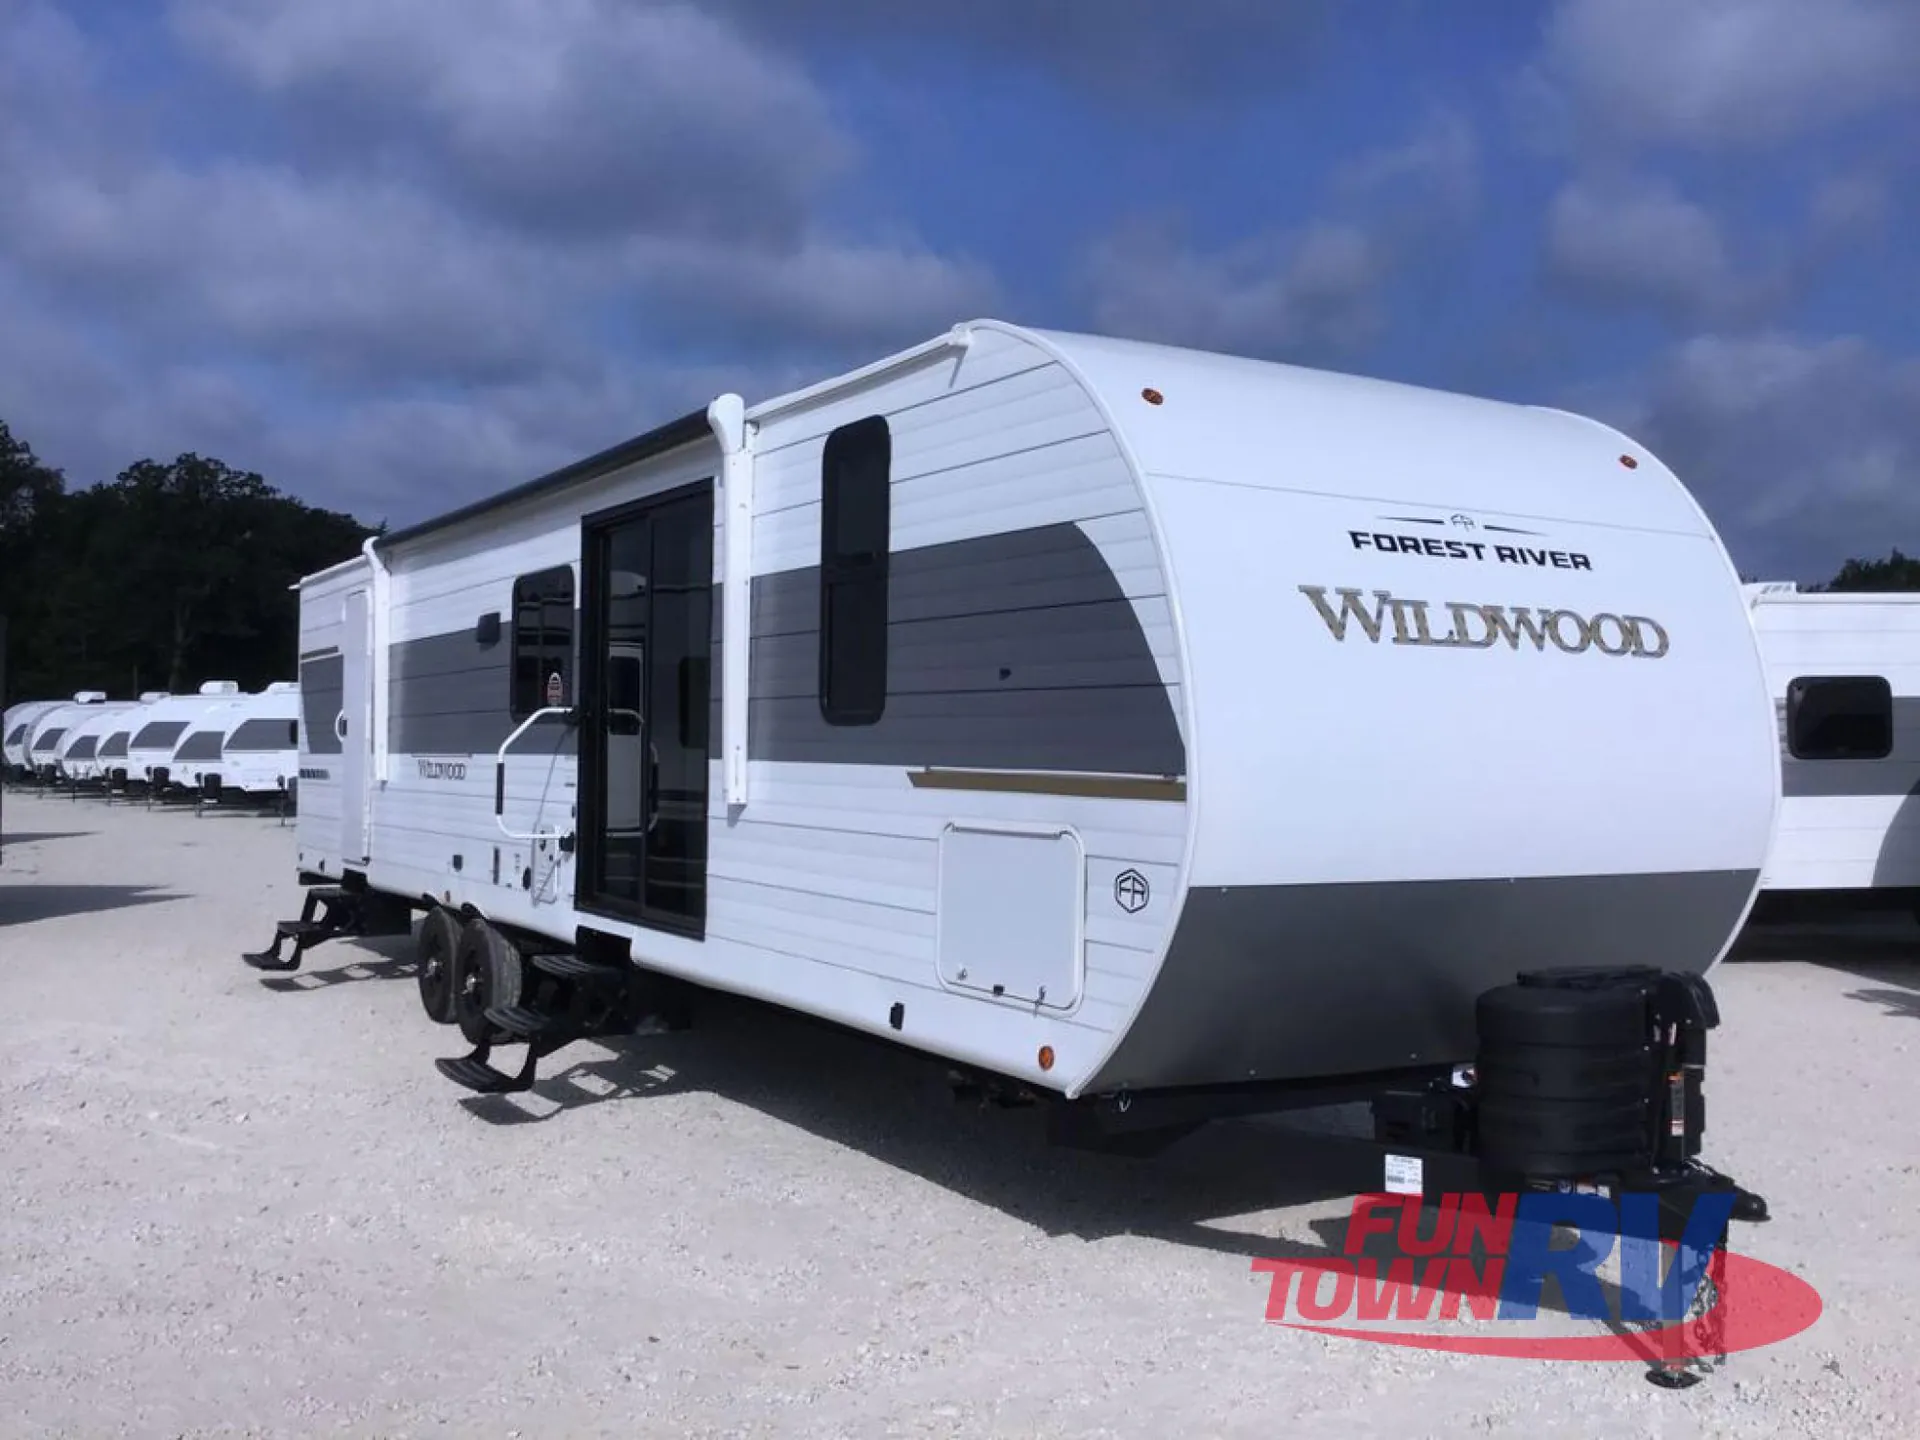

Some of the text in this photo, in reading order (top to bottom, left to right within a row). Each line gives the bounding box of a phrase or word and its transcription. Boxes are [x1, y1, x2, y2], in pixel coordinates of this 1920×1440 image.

[1348, 530, 1592, 570] FOREST RIVER
[1298, 584, 1669, 659] WILDWOOD
